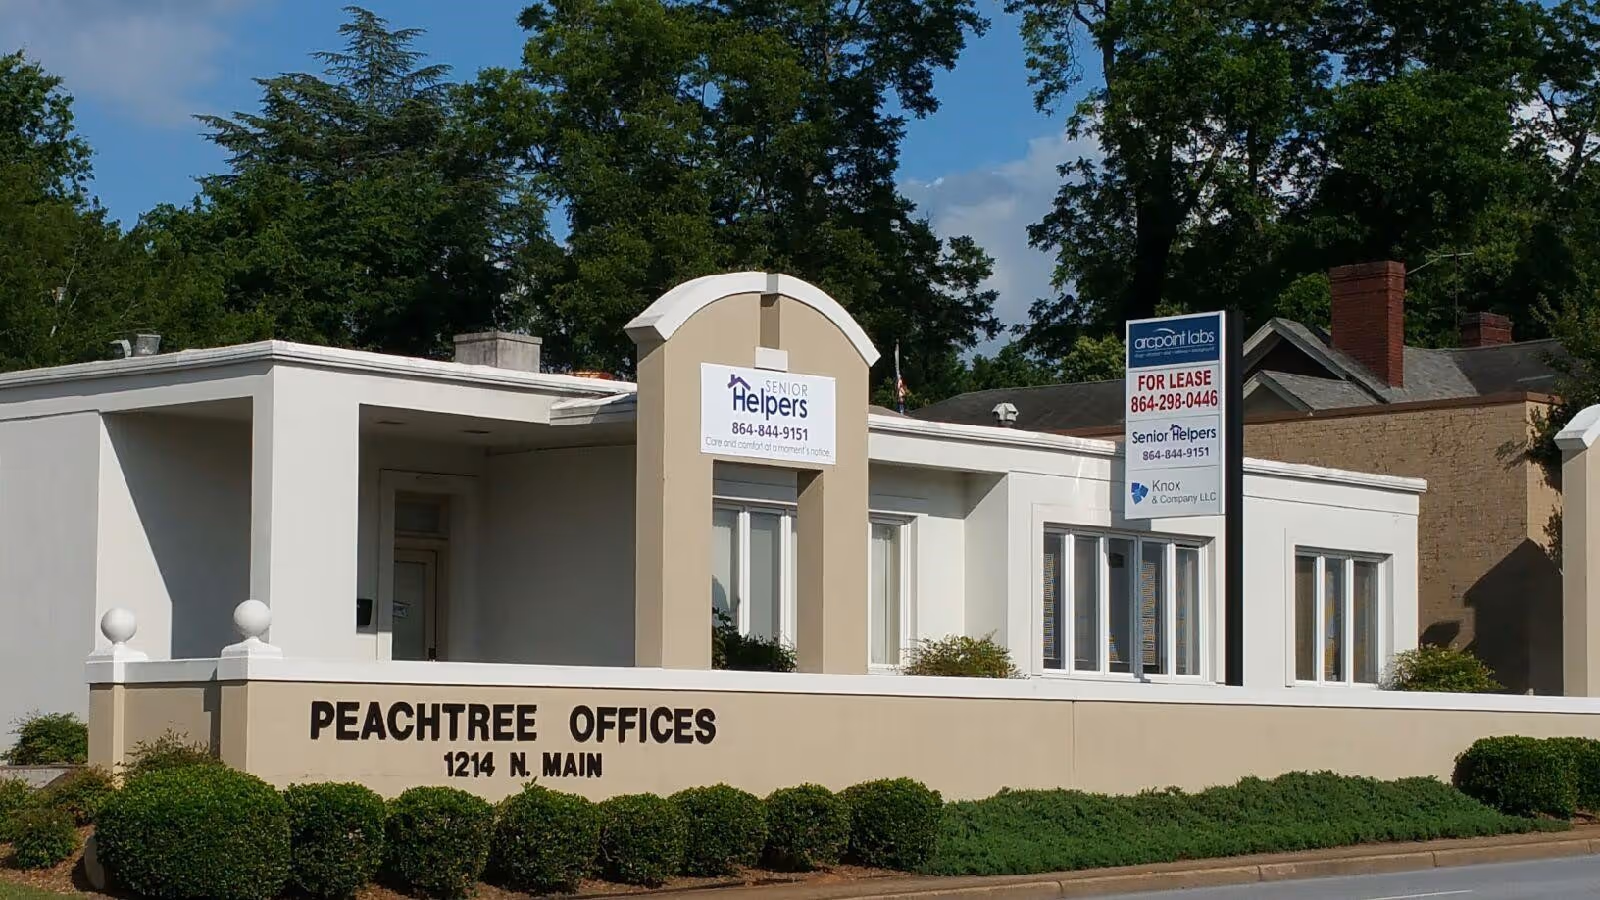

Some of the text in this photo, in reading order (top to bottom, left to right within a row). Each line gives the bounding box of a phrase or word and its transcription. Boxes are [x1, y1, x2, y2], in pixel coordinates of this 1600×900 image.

[1134, 328, 1215, 350] arcpoint labs
[765, 380, 808, 397] SENIOR
[1138, 370, 1212, 391] FOR LEASE
[733, 386, 808, 421] Helpers
[1131, 389, 1218, 413] 864-298-0446
[732, 421, 808, 441] 864-844-9151
[1132, 427, 1217, 444] Senior Helpers
[705, 436, 722, 446] Care
[723, 439, 737, 449] and
[738, 441, 763, 452] comfort
[764, 443, 772, 452] at
[778, 445, 810, 456] moment's
[1142, 446, 1210, 461] 864-844-9151
[1152, 480, 1181, 492] Knox
[1151, 491, 1217, 505] & Company LLC
[310, 701, 717, 744] PEACHTREE OFFICES
[443, 751, 603, 777] 1214 N. MAIN
